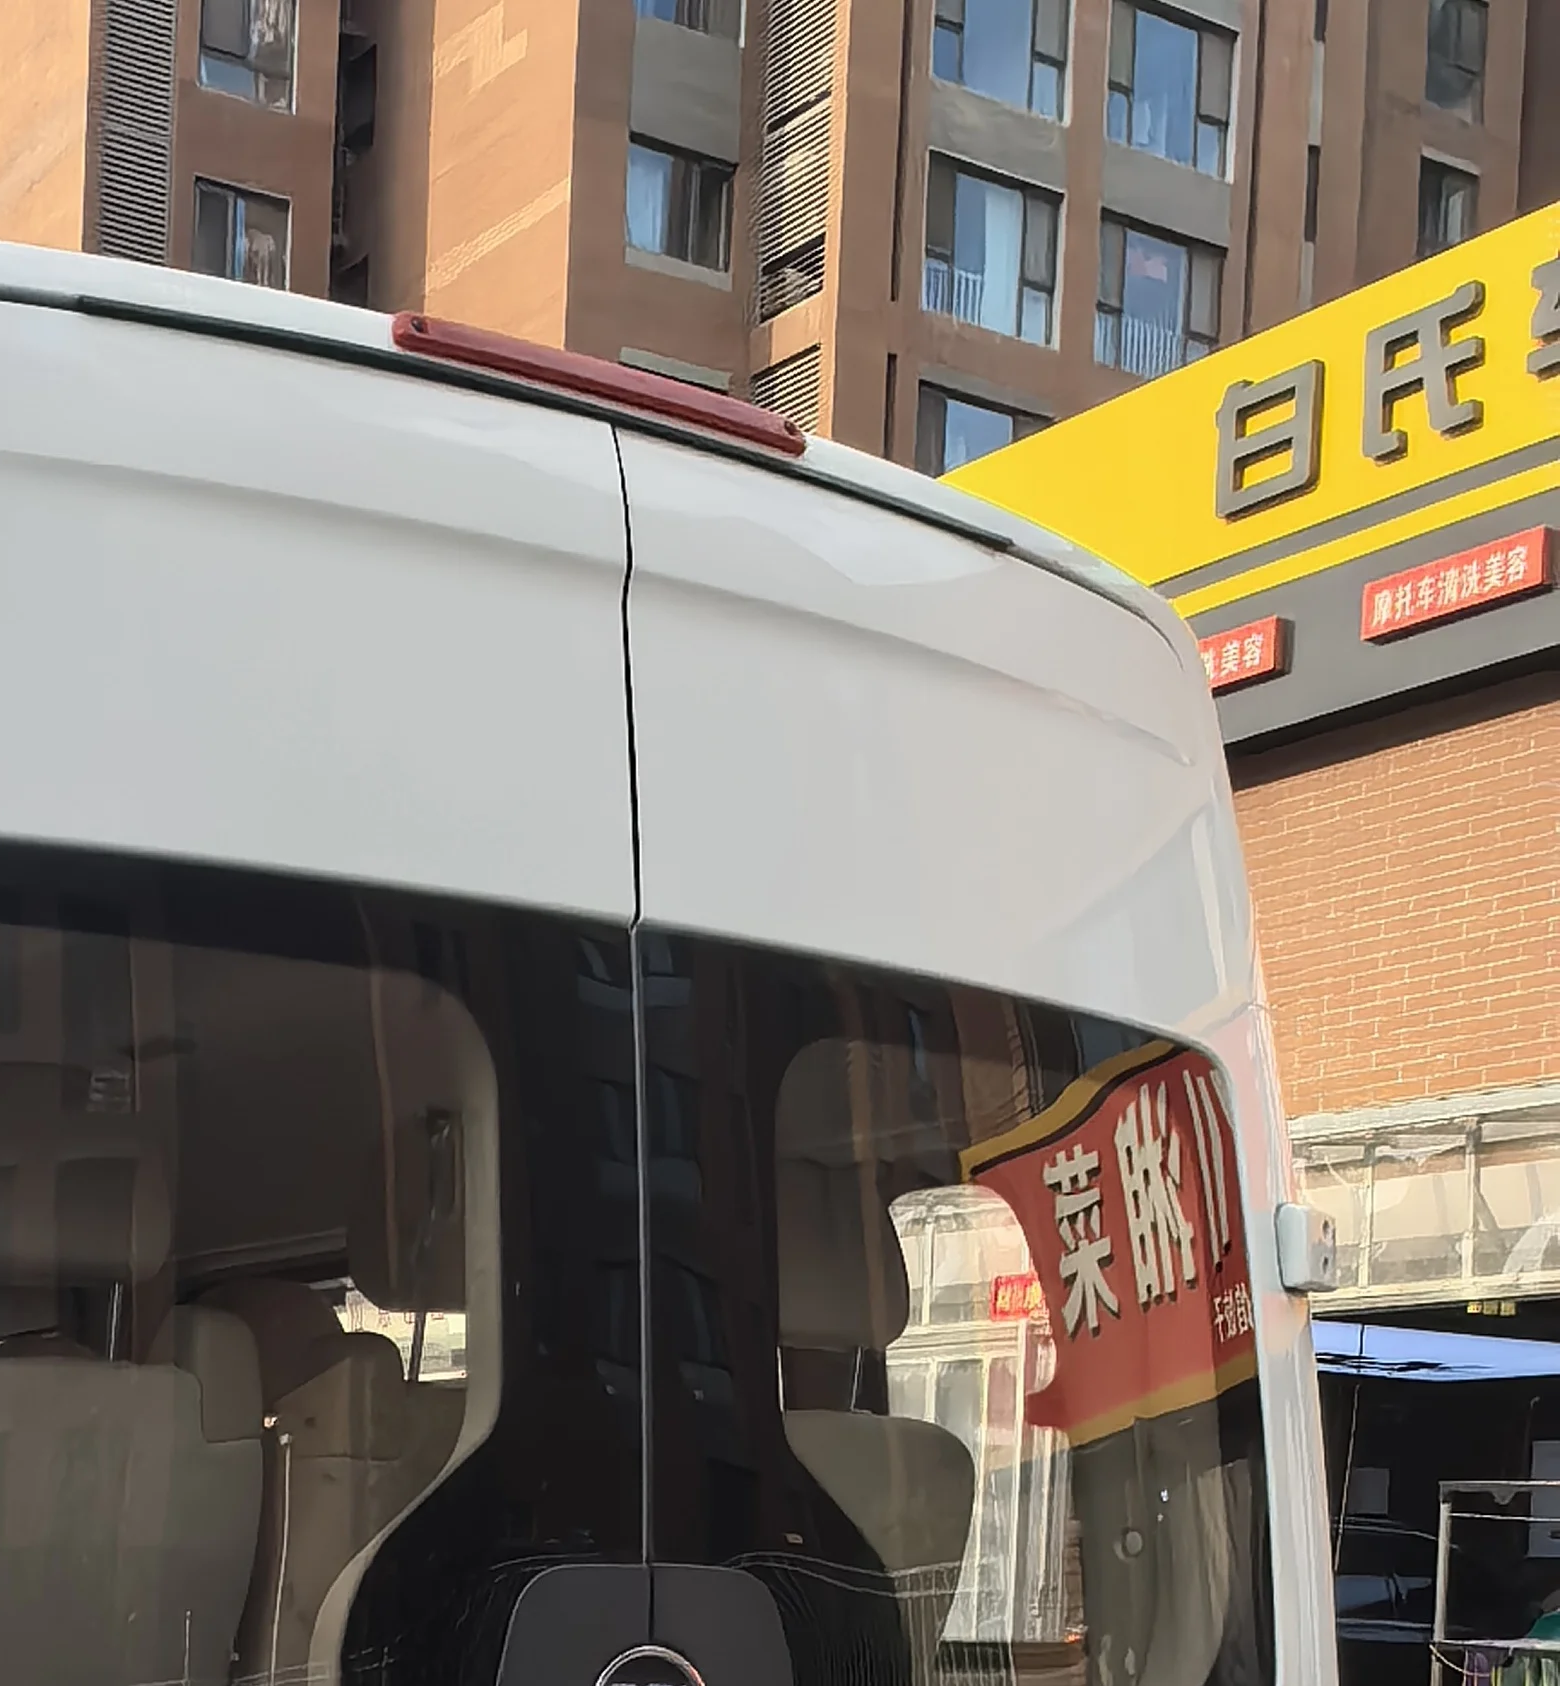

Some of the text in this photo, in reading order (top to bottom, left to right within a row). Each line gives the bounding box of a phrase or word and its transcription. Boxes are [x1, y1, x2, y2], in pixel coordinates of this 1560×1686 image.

[1216, 250, 1560, 522] 白氏
[1371, 544, 1529, 627] 摩托车清洗美容
